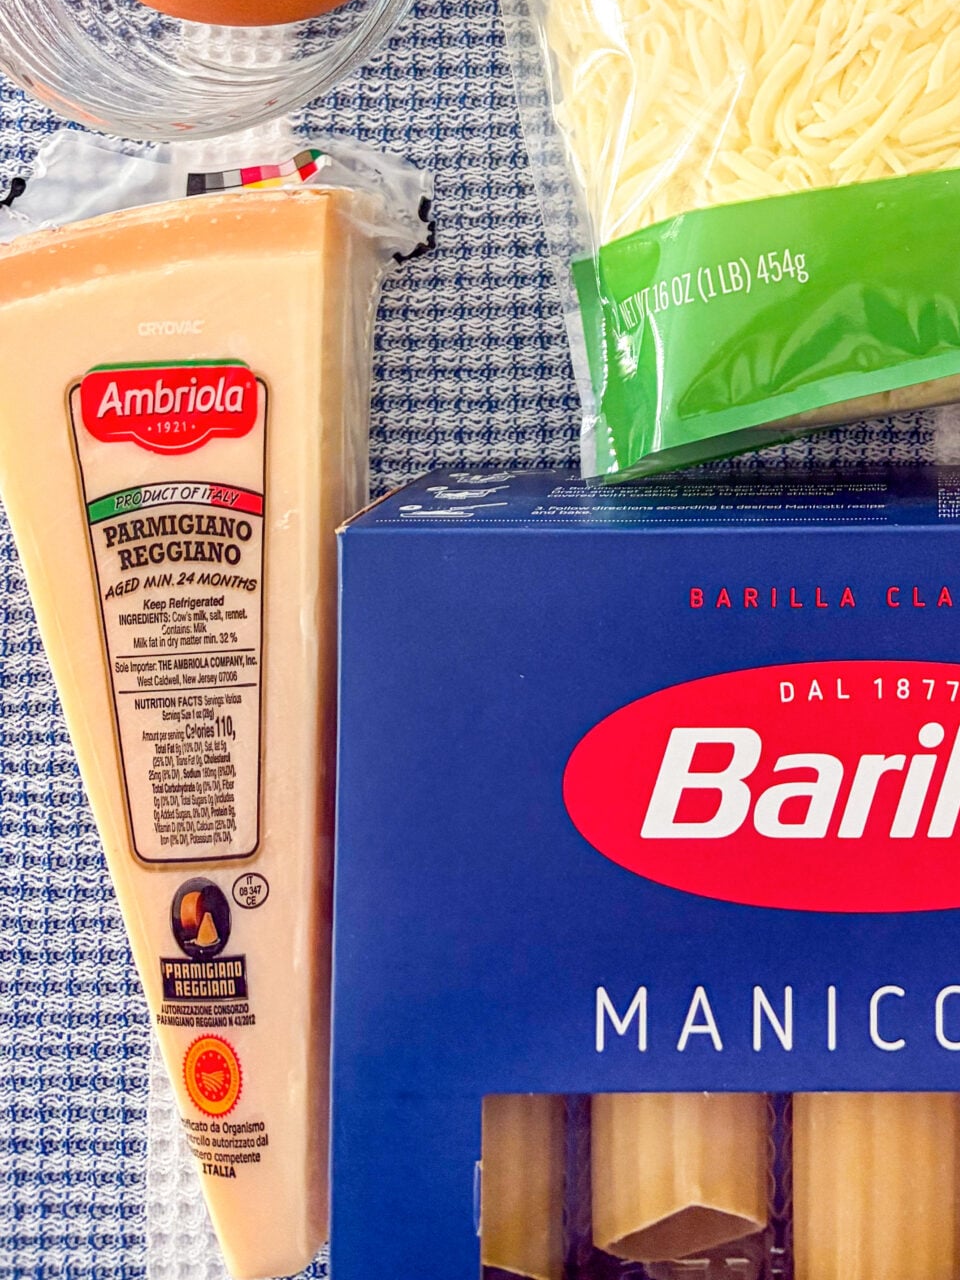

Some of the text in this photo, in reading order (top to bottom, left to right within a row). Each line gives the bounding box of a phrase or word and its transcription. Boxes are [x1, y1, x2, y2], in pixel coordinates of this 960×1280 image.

[653, 248, 809, 313] 16 OZ (1 LB) 454g
[137, 320, 205, 337] CRYOVAC
[96, 377, 245, 420] Ambriola
[156, 422, 188, 434] 1921
[115, 486, 240, 510] PRODUCT OF ITALY
[103, 514, 253, 548] PARMIGIANO
[118, 541, 241, 571] REGGIANO
[105, 572, 258, 600] AGED MIN. 24 MONTHS
[143, 595, 225, 611] Keep Refrigerated
[689, 586, 857, 610] BARILLA
[119, 613, 171, 626] INGREDIENTS:
[162, 623, 207, 636] Contains: Milk
[133, 634, 202, 649] Milk dry matter
[115, 657, 245, 673] Sole THE AMBRIOLA COMPANY,
[137, 671, 237, 687] West Caldwell, New Jersey 07006
[779, 678, 960, 704] DAL 1877
[135, 696, 203, 710] NUTRITION FACTS
[215, 715, 236, 741] 110,
[249, 885, 262, 895] 347
[245, 896, 256, 906] CE
[165, 960, 242, 979] PARMIGIANO
[175, 979, 236, 997] REGGIANO
[214, 1003, 249, 1014] CONSORZIO
[222, 1121, 265, 1136] Organismo
[212, 1133, 268, 1148] autorizzato dal
[214, 1152, 261, 1165] competente
[203, 1163, 236, 1179] ITALIA
